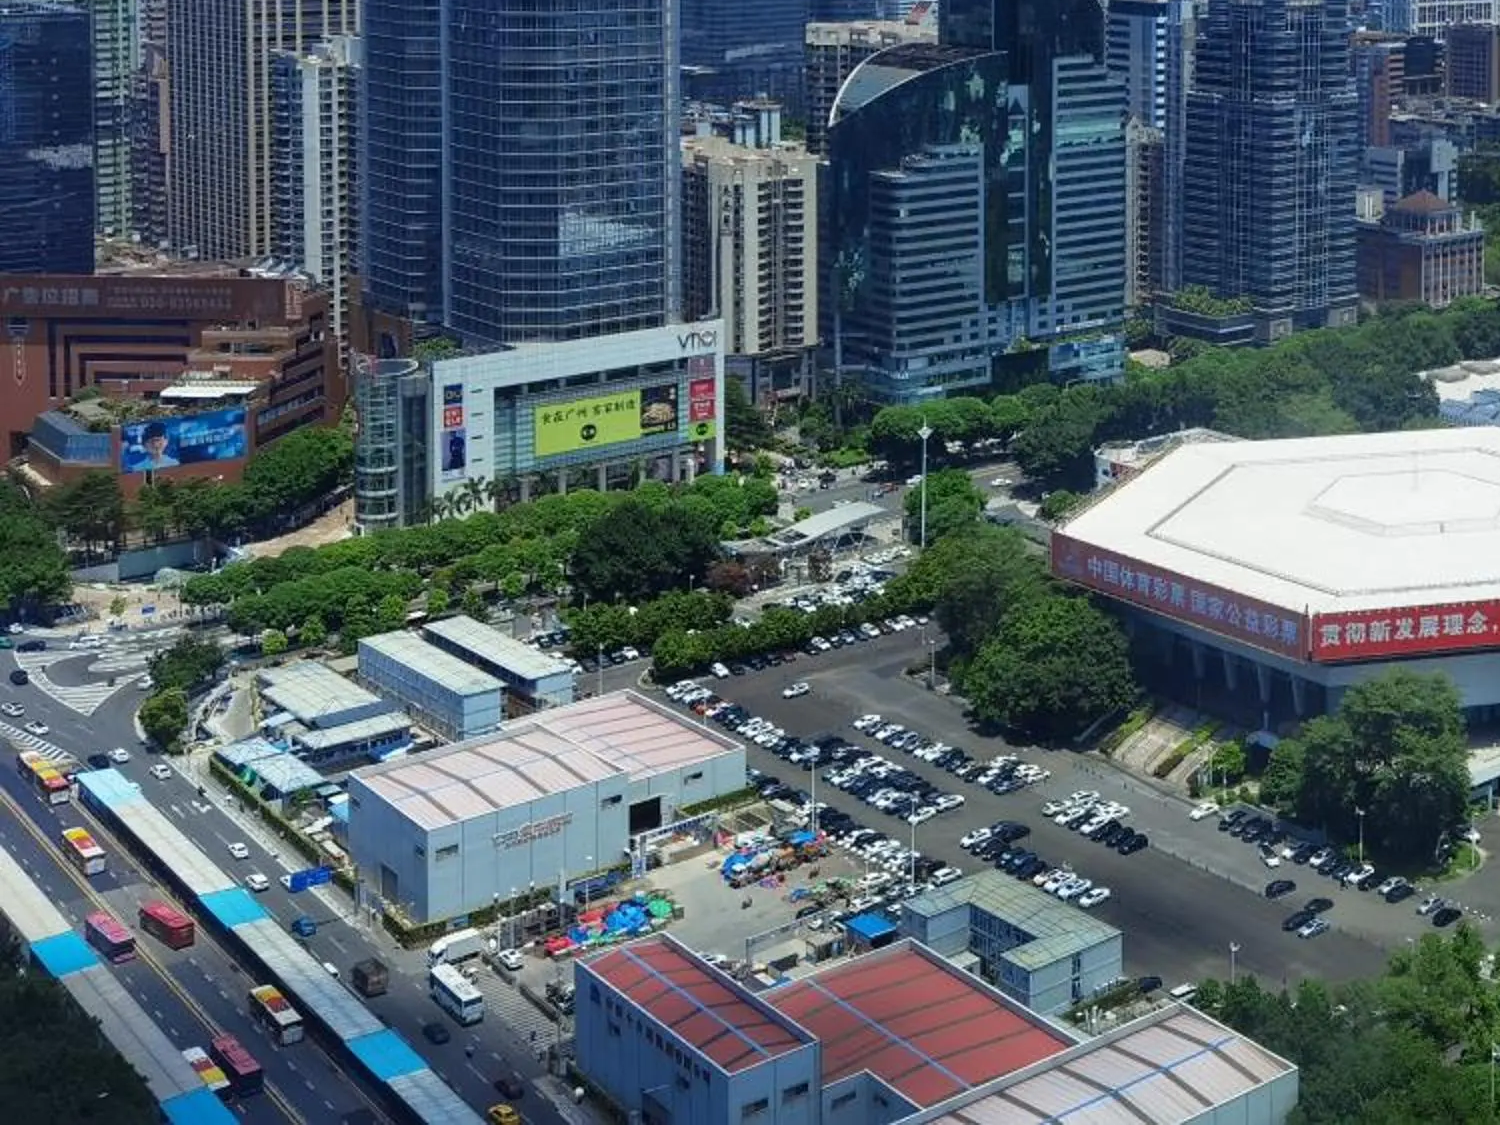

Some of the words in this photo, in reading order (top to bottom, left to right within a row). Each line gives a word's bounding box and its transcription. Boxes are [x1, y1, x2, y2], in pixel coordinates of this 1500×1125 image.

[1086, 555, 1185, 608] 中国体育彩票
